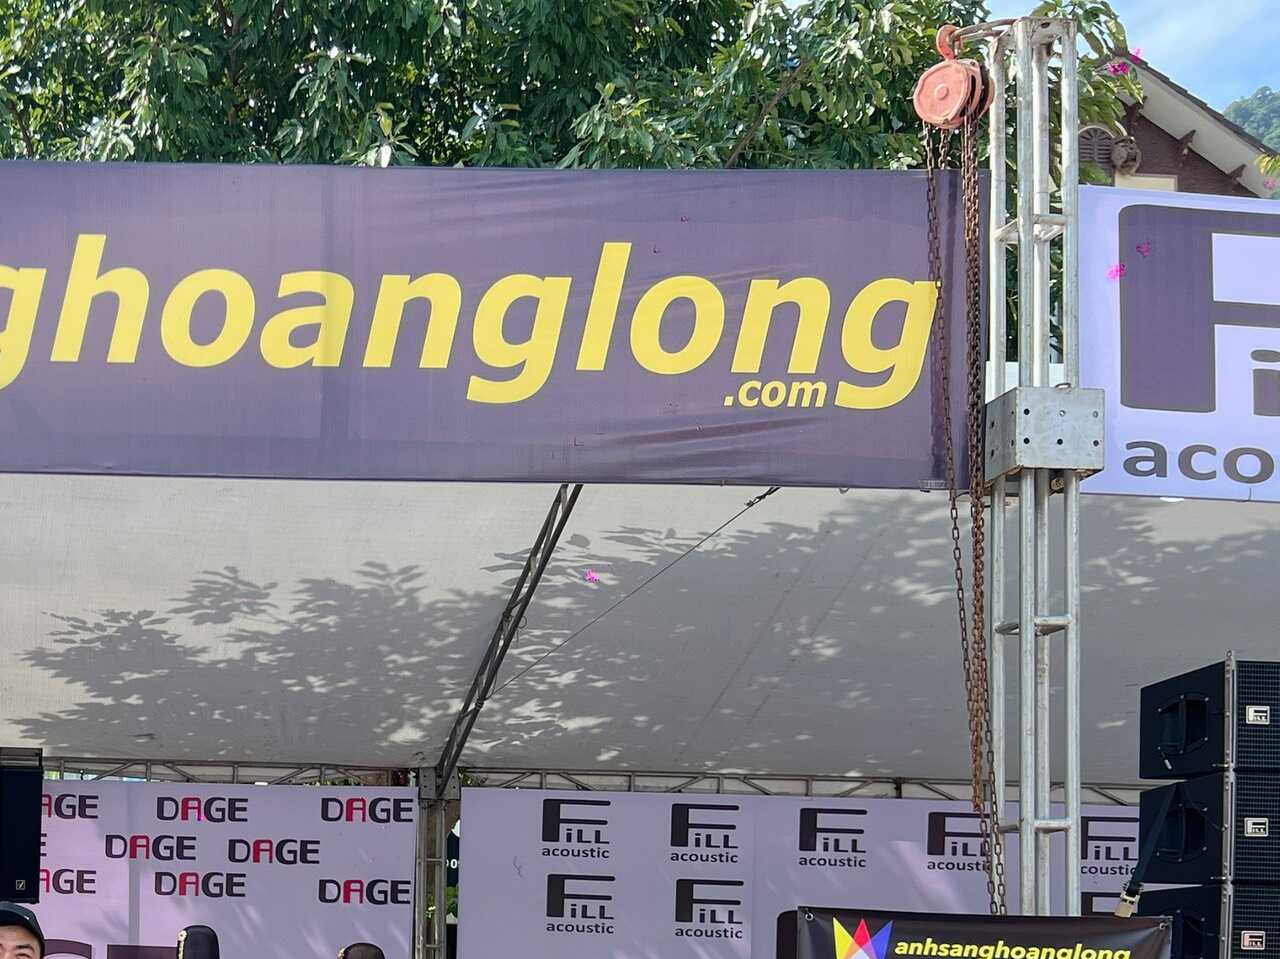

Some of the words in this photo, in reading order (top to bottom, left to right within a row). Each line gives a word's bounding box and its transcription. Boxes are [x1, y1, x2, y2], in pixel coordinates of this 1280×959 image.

[725, 376, 826, 409] .com
[157, 797, 248, 823] DAGE
[321, 797, 414, 824] DAGE
[105, 834, 197, 861] DAGE
[228, 838, 320, 865] DAGE
[542, 846, 610, 859] acoustic
[670, 850, 738, 864] acoustic
[798, 855, 866, 869] acoustic
[1081, 864, 1136, 876] coustic
[154, 871, 246, 898] DAGE
[318, 879, 411, 905] DAGE
[546, 921, 614, 935] acoustic
[674, 926, 743, 939] acoustic
